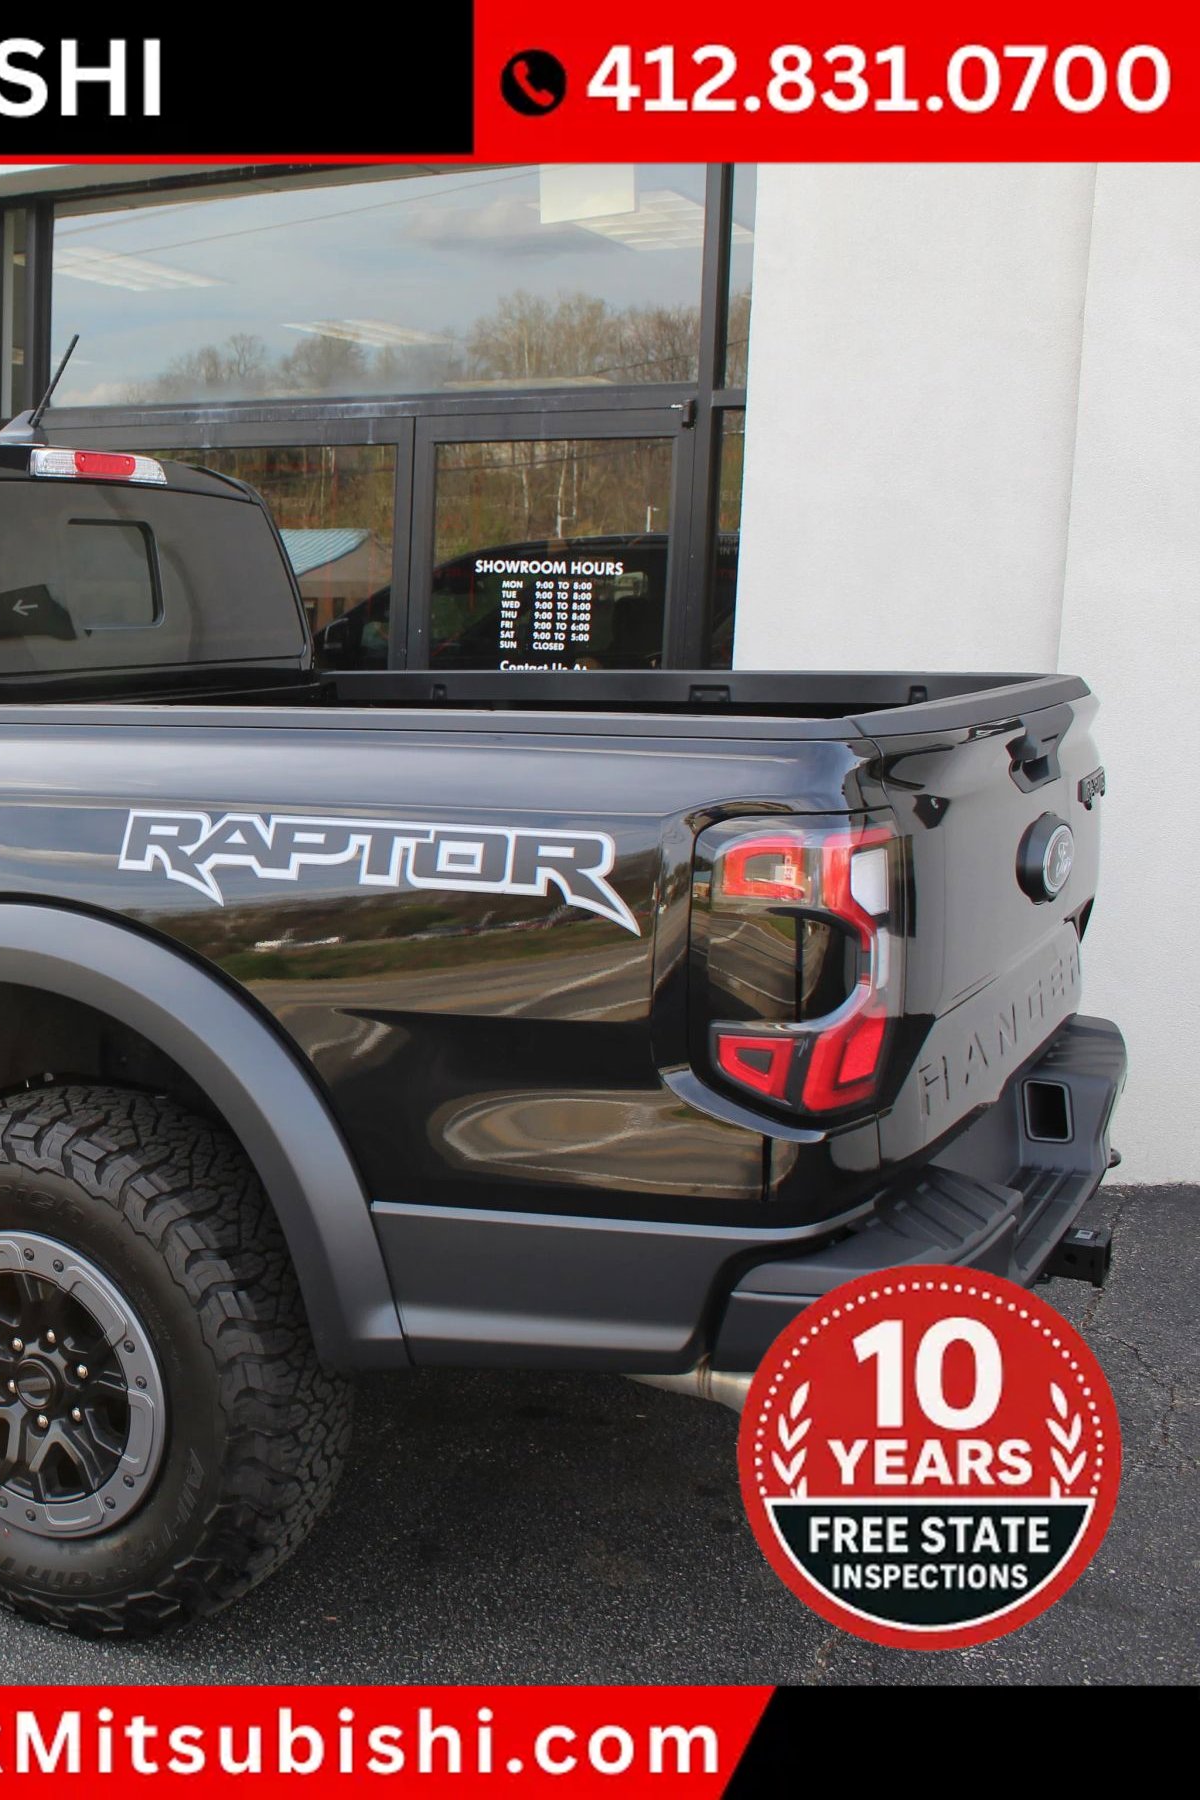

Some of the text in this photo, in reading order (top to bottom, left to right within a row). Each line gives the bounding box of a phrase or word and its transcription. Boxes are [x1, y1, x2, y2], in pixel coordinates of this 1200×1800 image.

[474, 560, 624, 576] SHOWROOM HOURS
[502, 581, 593, 591] MON 9:00 TO 8:00
[501, 590, 592, 602] TUE 9:00 TO 8:00
[501, 600, 592, 612] WED 9:00 TO 8:00
[500, 610, 591, 622] THU 9:00 TO 8:00
[500, 620, 590, 632] FRI 9:00 TO 6:00
[500, 630, 590, 642] SAT 9:00 TO 5:00
[499, 640, 565, 651] SUN CLOSED
[500, 660, 548, 671] Contact
[118, 806, 643, 938] RAPTOR
